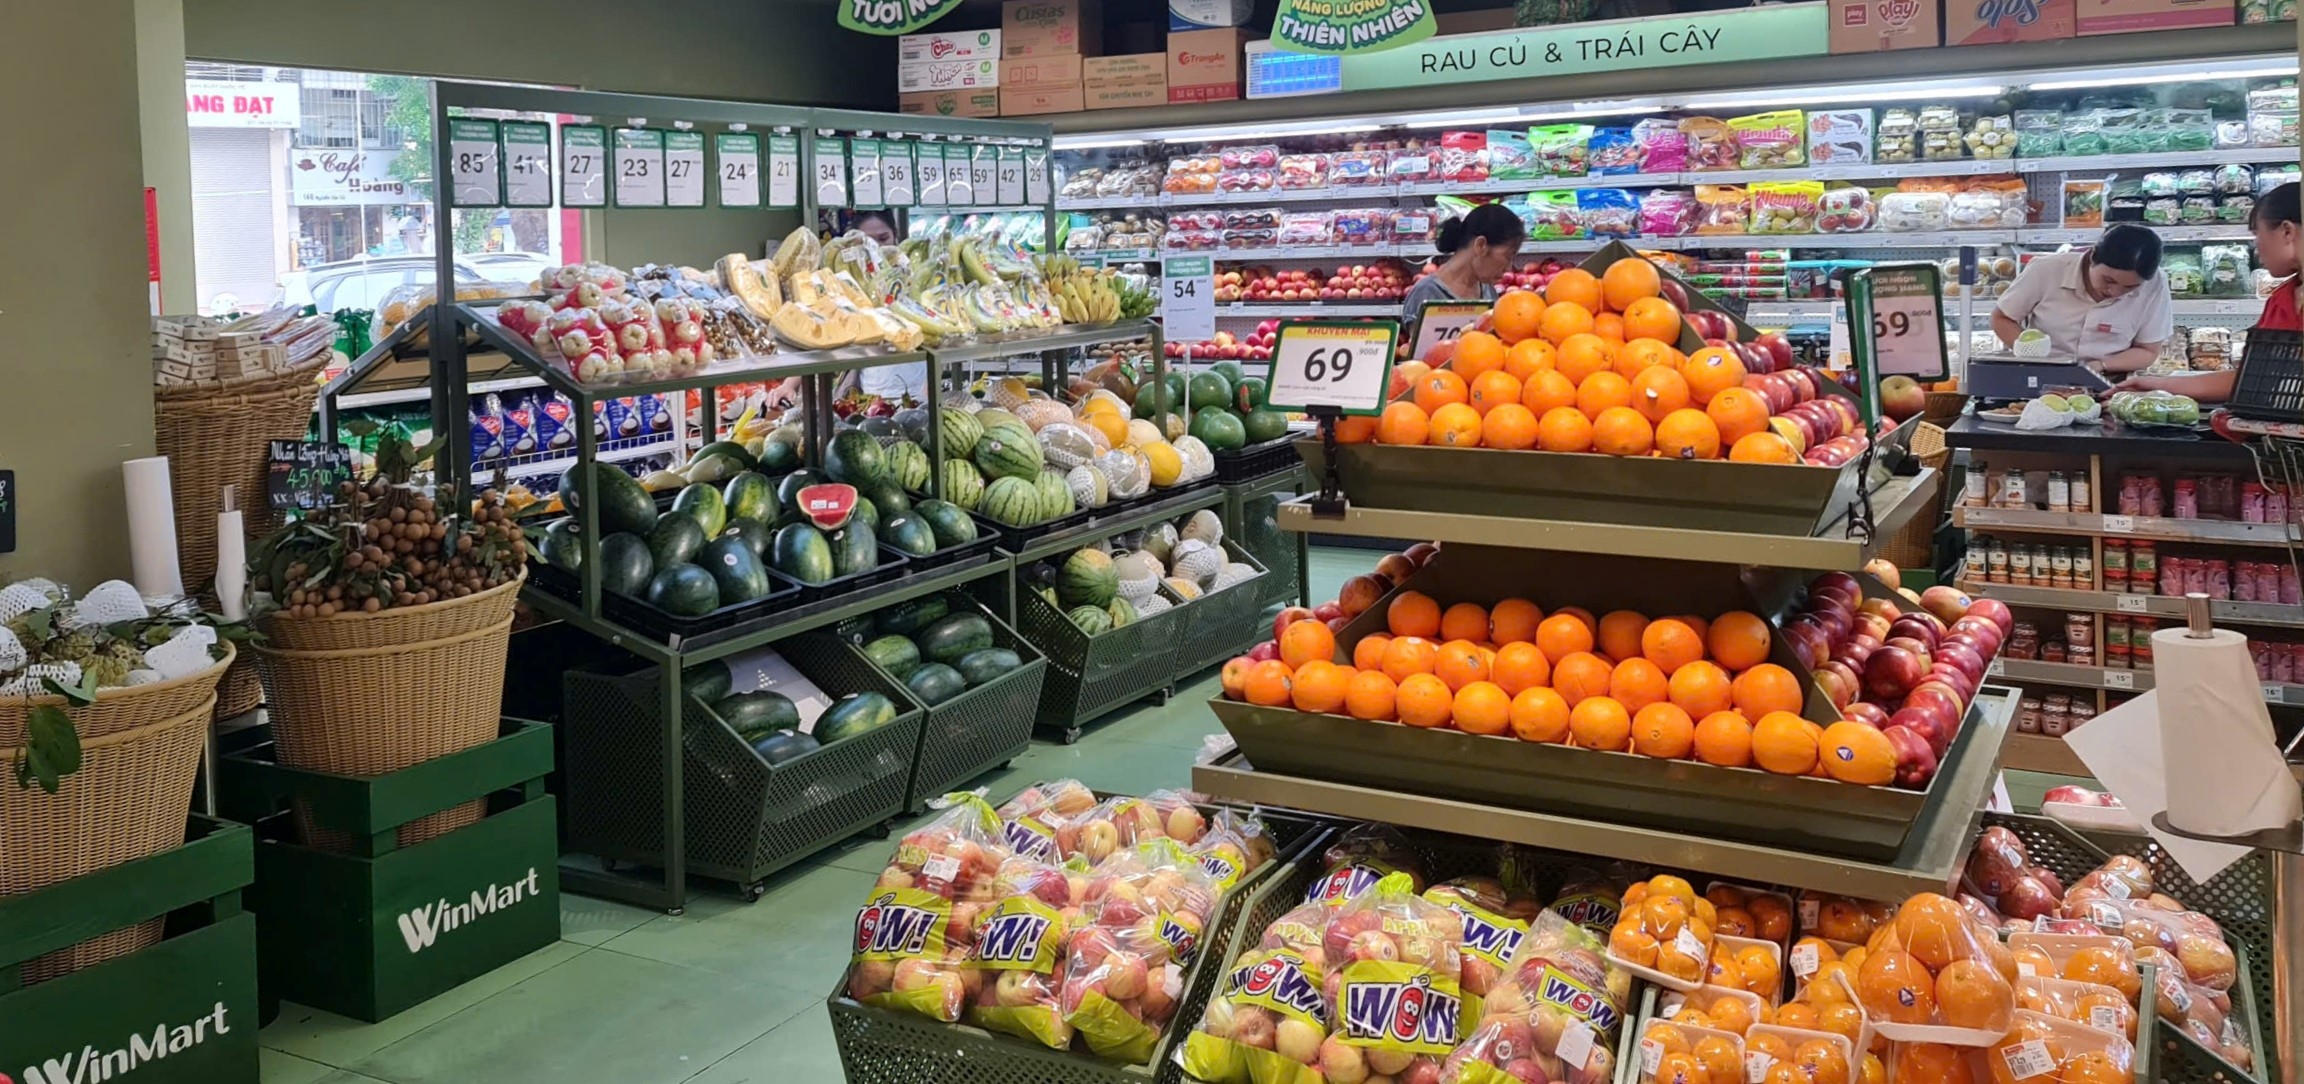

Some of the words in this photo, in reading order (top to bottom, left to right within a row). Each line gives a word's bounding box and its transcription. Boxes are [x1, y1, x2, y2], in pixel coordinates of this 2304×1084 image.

[1281, 16, 1346, 45] THIÊN
[1352, 1, 1423, 43] NHIÊN
[1421, 49, 1476, 73] RAU
[1489, 36, 1527, 67] CỦ
[1544, 42, 1562, 63] &
[1576, 30, 1644, 61] TRÁI
[1659, 24, 1721, 53] CÂY
[233, 96, 274, 118] ĐẠT
[460, 153, 483, 174] 85
[570, 155, 591, 173] 27
[623, 158, 648, 177] 23
[671, 160, 691, 178] 27
[726, 163, 747, 180] 24
[777, 161, 790, 177] 21
[820, 164, 837, 180] 34
[888, 165, 905, 181] 36
[923, 167, 937, 182] 59
[949, 167, 964, 182] 65
[974, 169, 988, 183] 59
[1001, 169, 1015, 183] 42
[1030, 167, 1042, 182] 29
[1174, 280, 1196, 298] 54
[1304, 347, 1353, 382] 69
[397, 867, 540, 954] WinMart
[22, 1001, 231, 1084] WinMart
